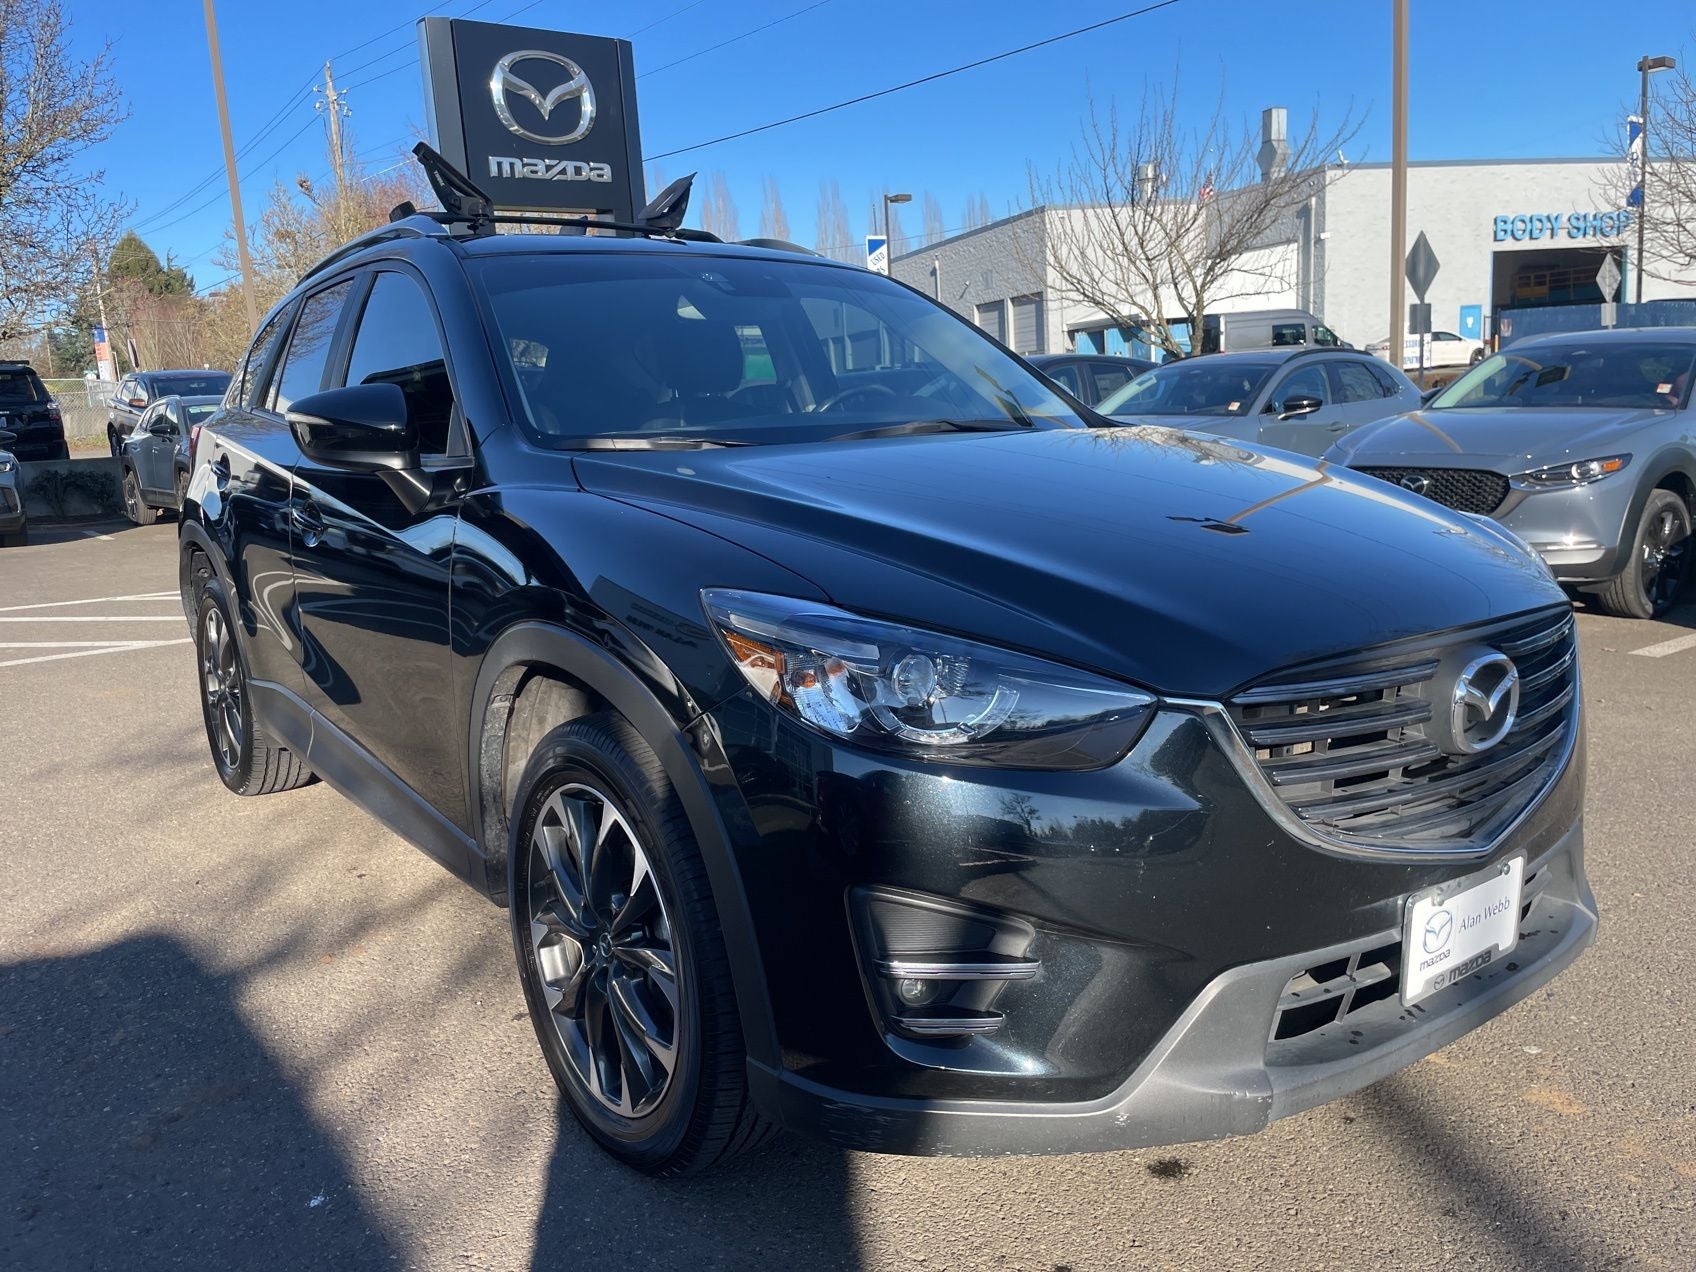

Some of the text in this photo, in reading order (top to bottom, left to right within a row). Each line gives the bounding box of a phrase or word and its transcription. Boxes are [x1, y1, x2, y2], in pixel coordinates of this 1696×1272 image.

[1493, 209, 1634, 242] BODY SHOP
[1458, 896, 1511, 934] Alan Webb
